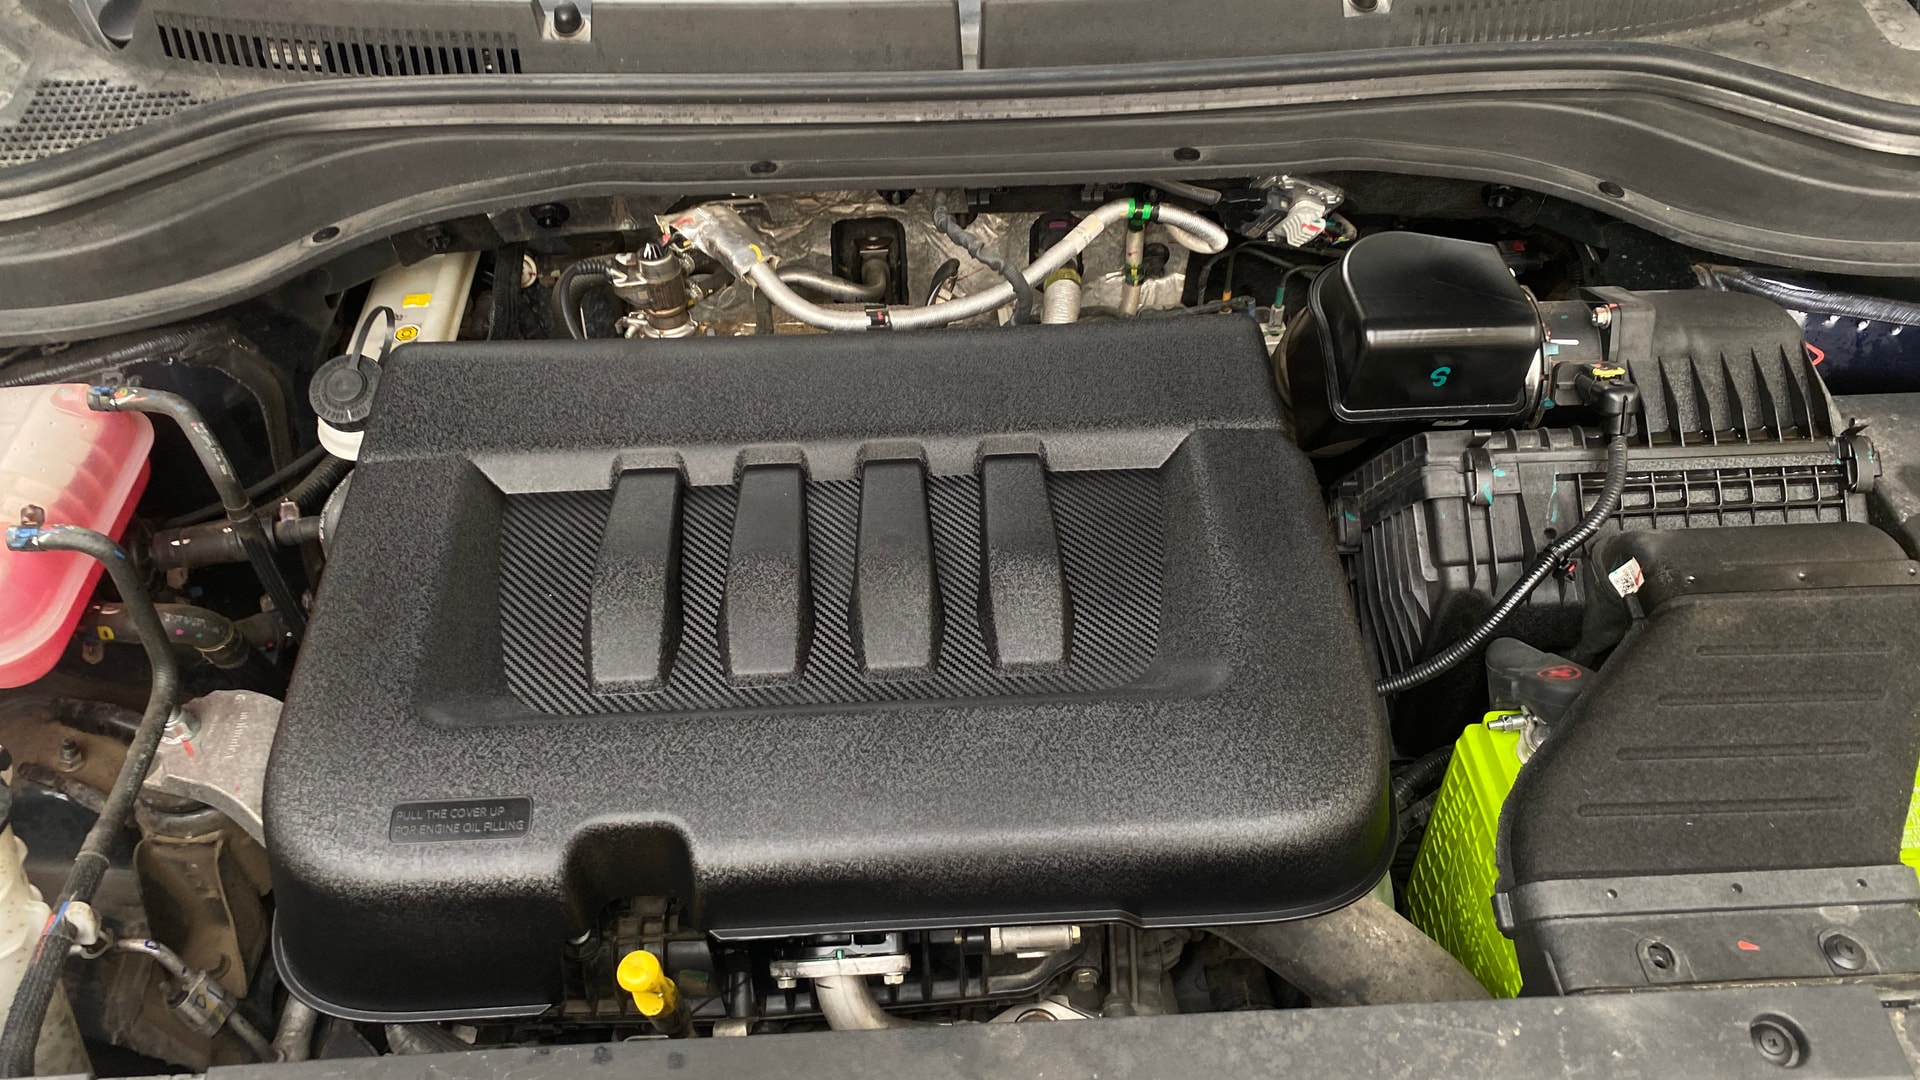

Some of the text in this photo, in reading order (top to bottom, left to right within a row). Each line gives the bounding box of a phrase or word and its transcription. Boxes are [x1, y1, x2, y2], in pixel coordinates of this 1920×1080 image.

[396, 806, 505, 820] PULL THE COVER UP
[394, 820, 525, 836] FOR ENGINE OIL FILLING
